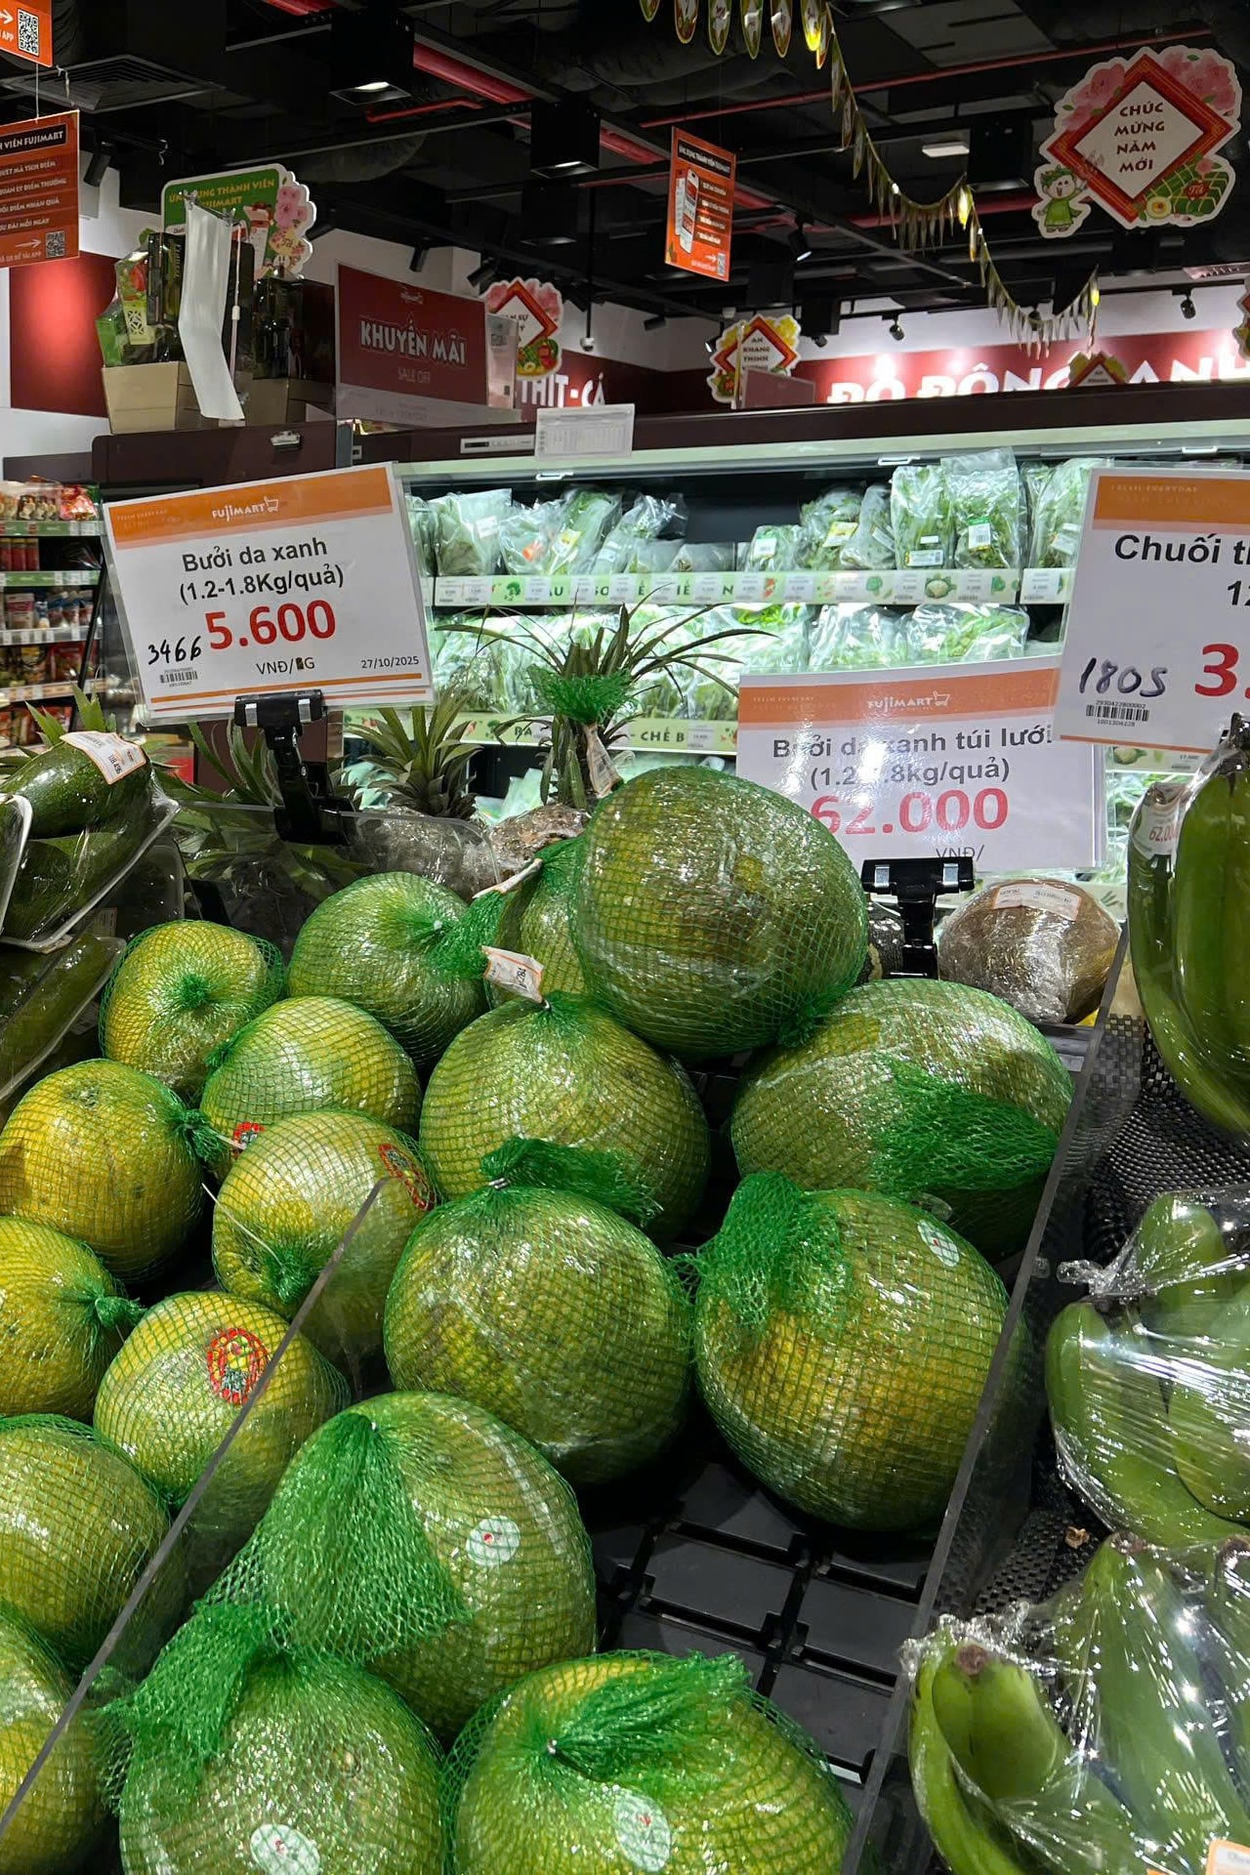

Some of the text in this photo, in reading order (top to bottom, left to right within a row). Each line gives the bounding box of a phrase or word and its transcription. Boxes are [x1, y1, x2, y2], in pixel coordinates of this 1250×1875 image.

[1, 28, 14, 42] APP
[1119, 100, 1164, 117] CHÚC
[23, 130, 64, 147] FUJIMART
[1114, 120, 1165, 137] MỪNG
[1116, 140, 1156, 155] NĂM
[1119, 158, 1154, 173] MỚI
[211, 502, 264, 522] FUJIMART
[182, 537, 328, 573] Bưởi da xanh
[1114, 533, 1222, 564] Chuối
[179, 564, 345, 606] (1.2-1.8Kg/quả)
[204, 599, 337, 651] 5.600
[147, 636, 202, 665] 3466
[255, 656, 315, 676] VNĐ/G
[360, 655, 420, 669] 27/10/2025
[956, 729, 991, 749] túi
[809, 787, 1009, 836] 62.000
